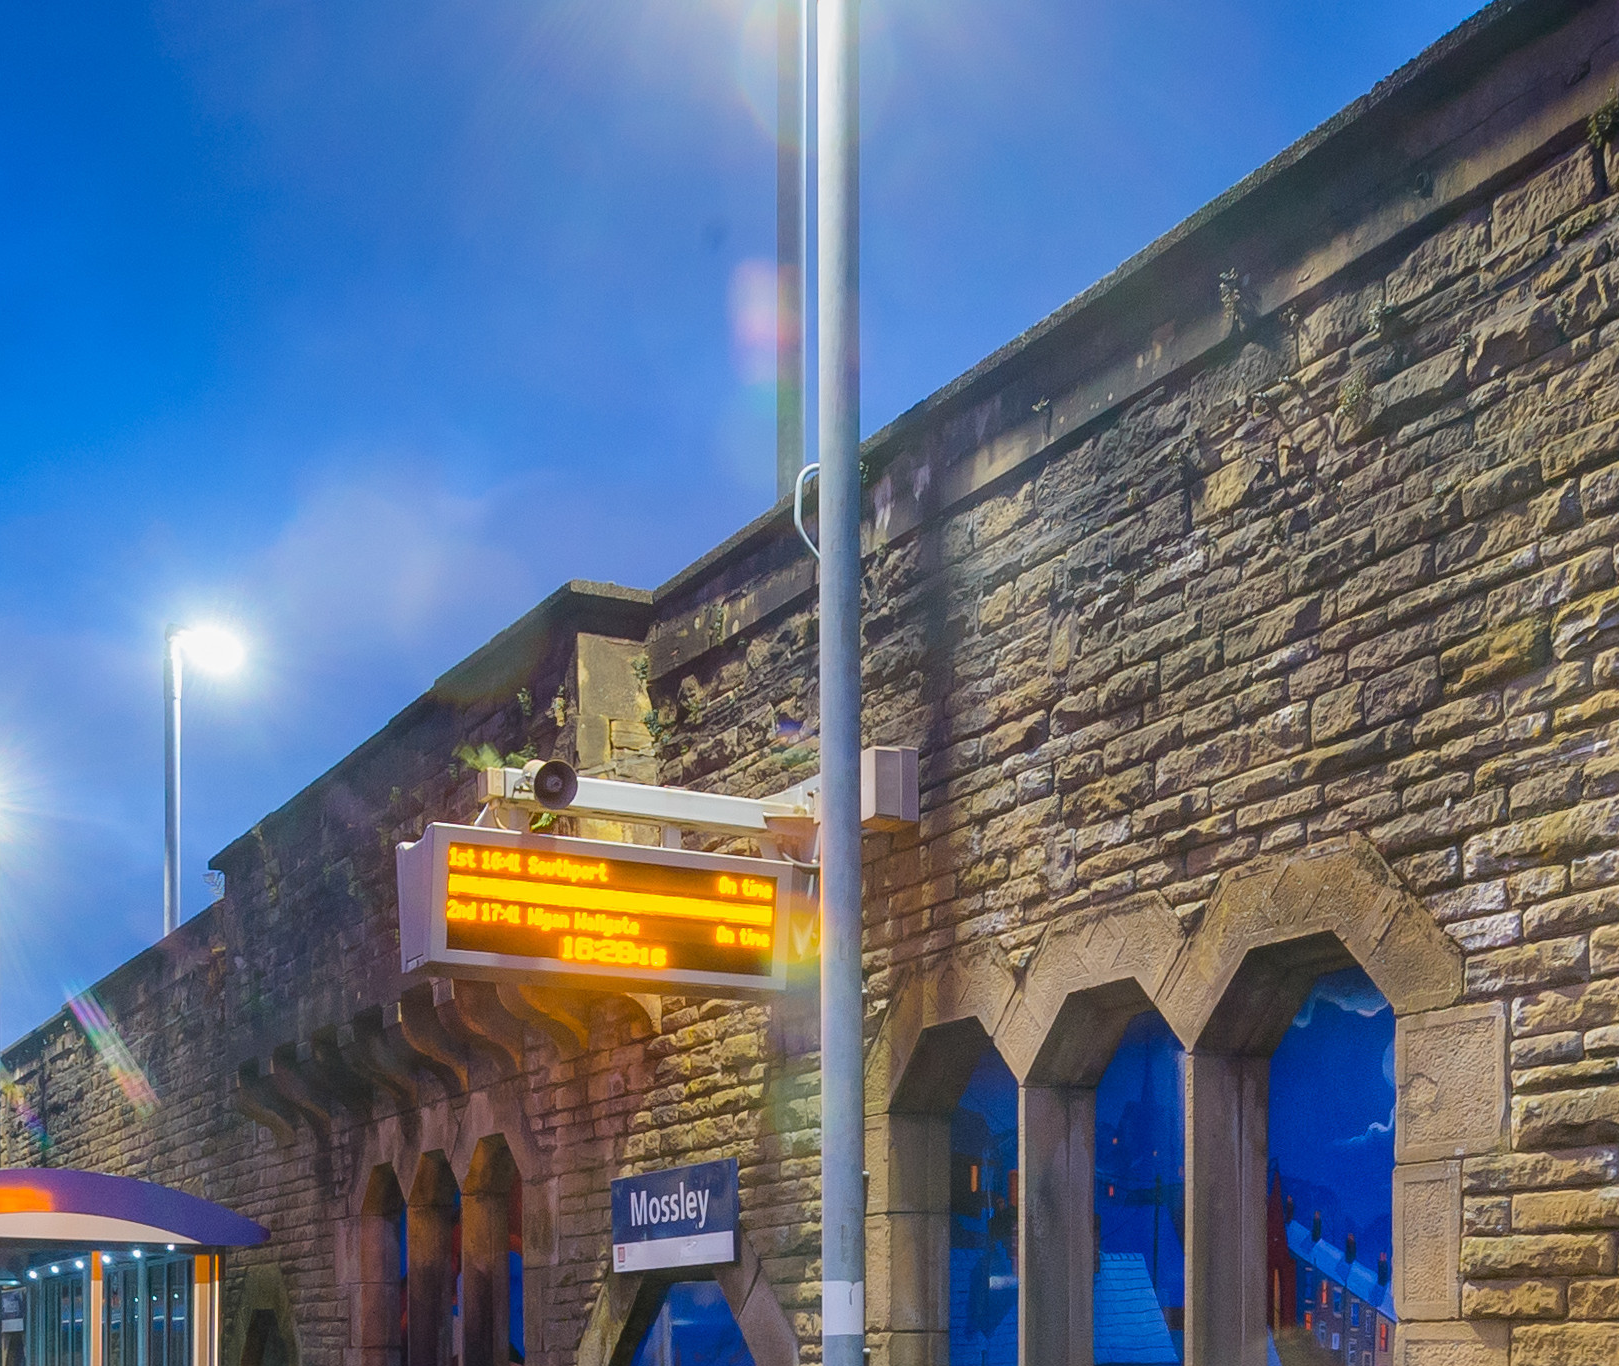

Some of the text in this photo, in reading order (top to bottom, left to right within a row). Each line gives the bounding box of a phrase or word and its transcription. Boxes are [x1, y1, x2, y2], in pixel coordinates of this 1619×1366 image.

[449, 847, 476, 868] 1st
[528, 855, 608, 882] Southport
[718, 875, 737, 895] On
[742, 878, 773, 899] time
[446, 899, 476, 920] 2nd
[527, 906, 570, 931] Wigan
[574, 911, 640, 937] Wallgate
[716, 925, 735, 944] On
[739, 927, 770, 947] time
[630, 1182, 710, 1229] Mossley
